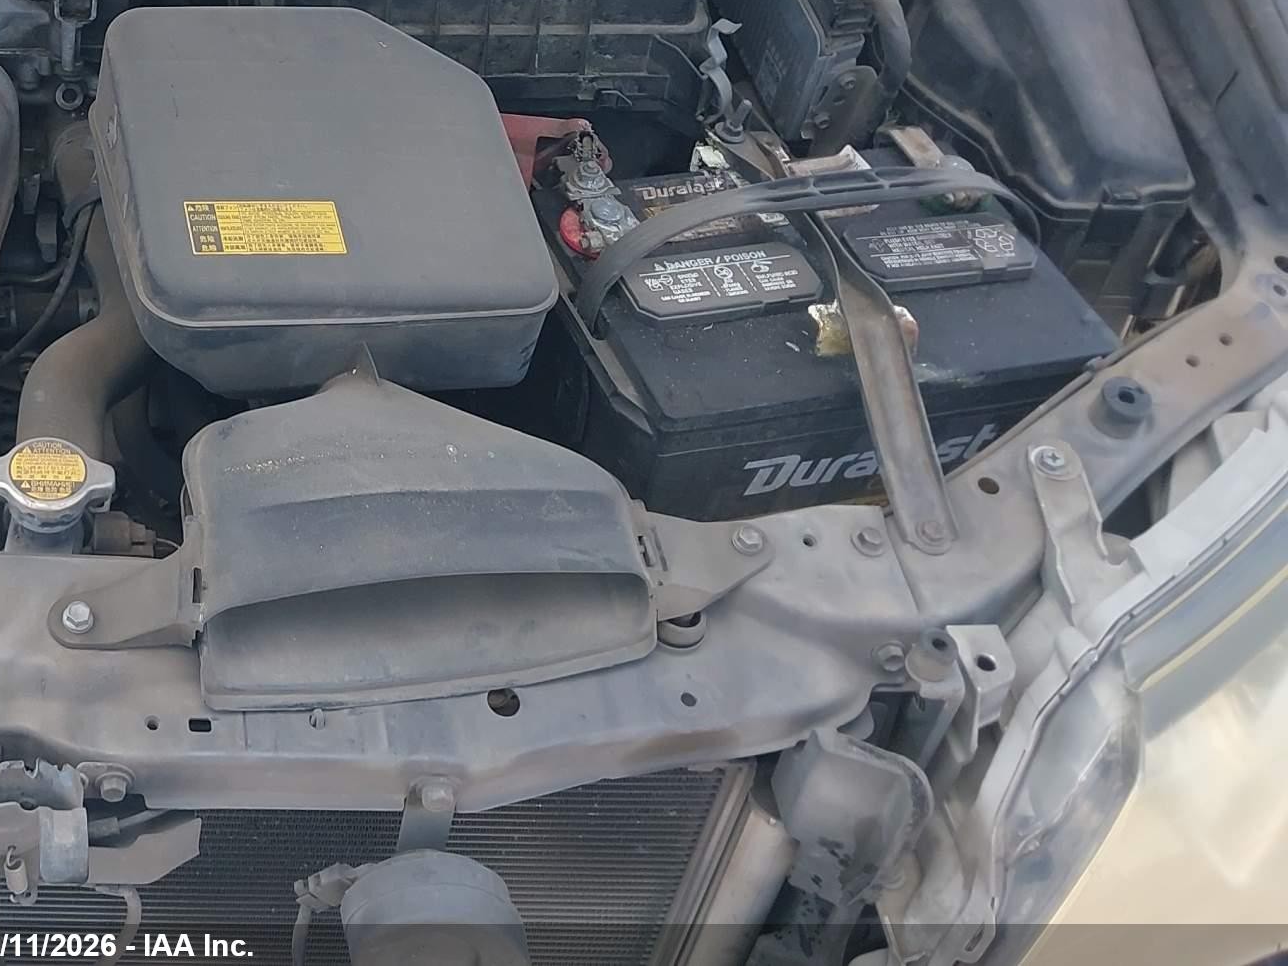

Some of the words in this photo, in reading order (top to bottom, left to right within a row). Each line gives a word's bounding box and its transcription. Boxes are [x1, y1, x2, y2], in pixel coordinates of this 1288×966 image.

[666, 257, 713, 270] DANGER
[723, 250, 767, 262] POISON
[743, 423, 998, 496] Durast
